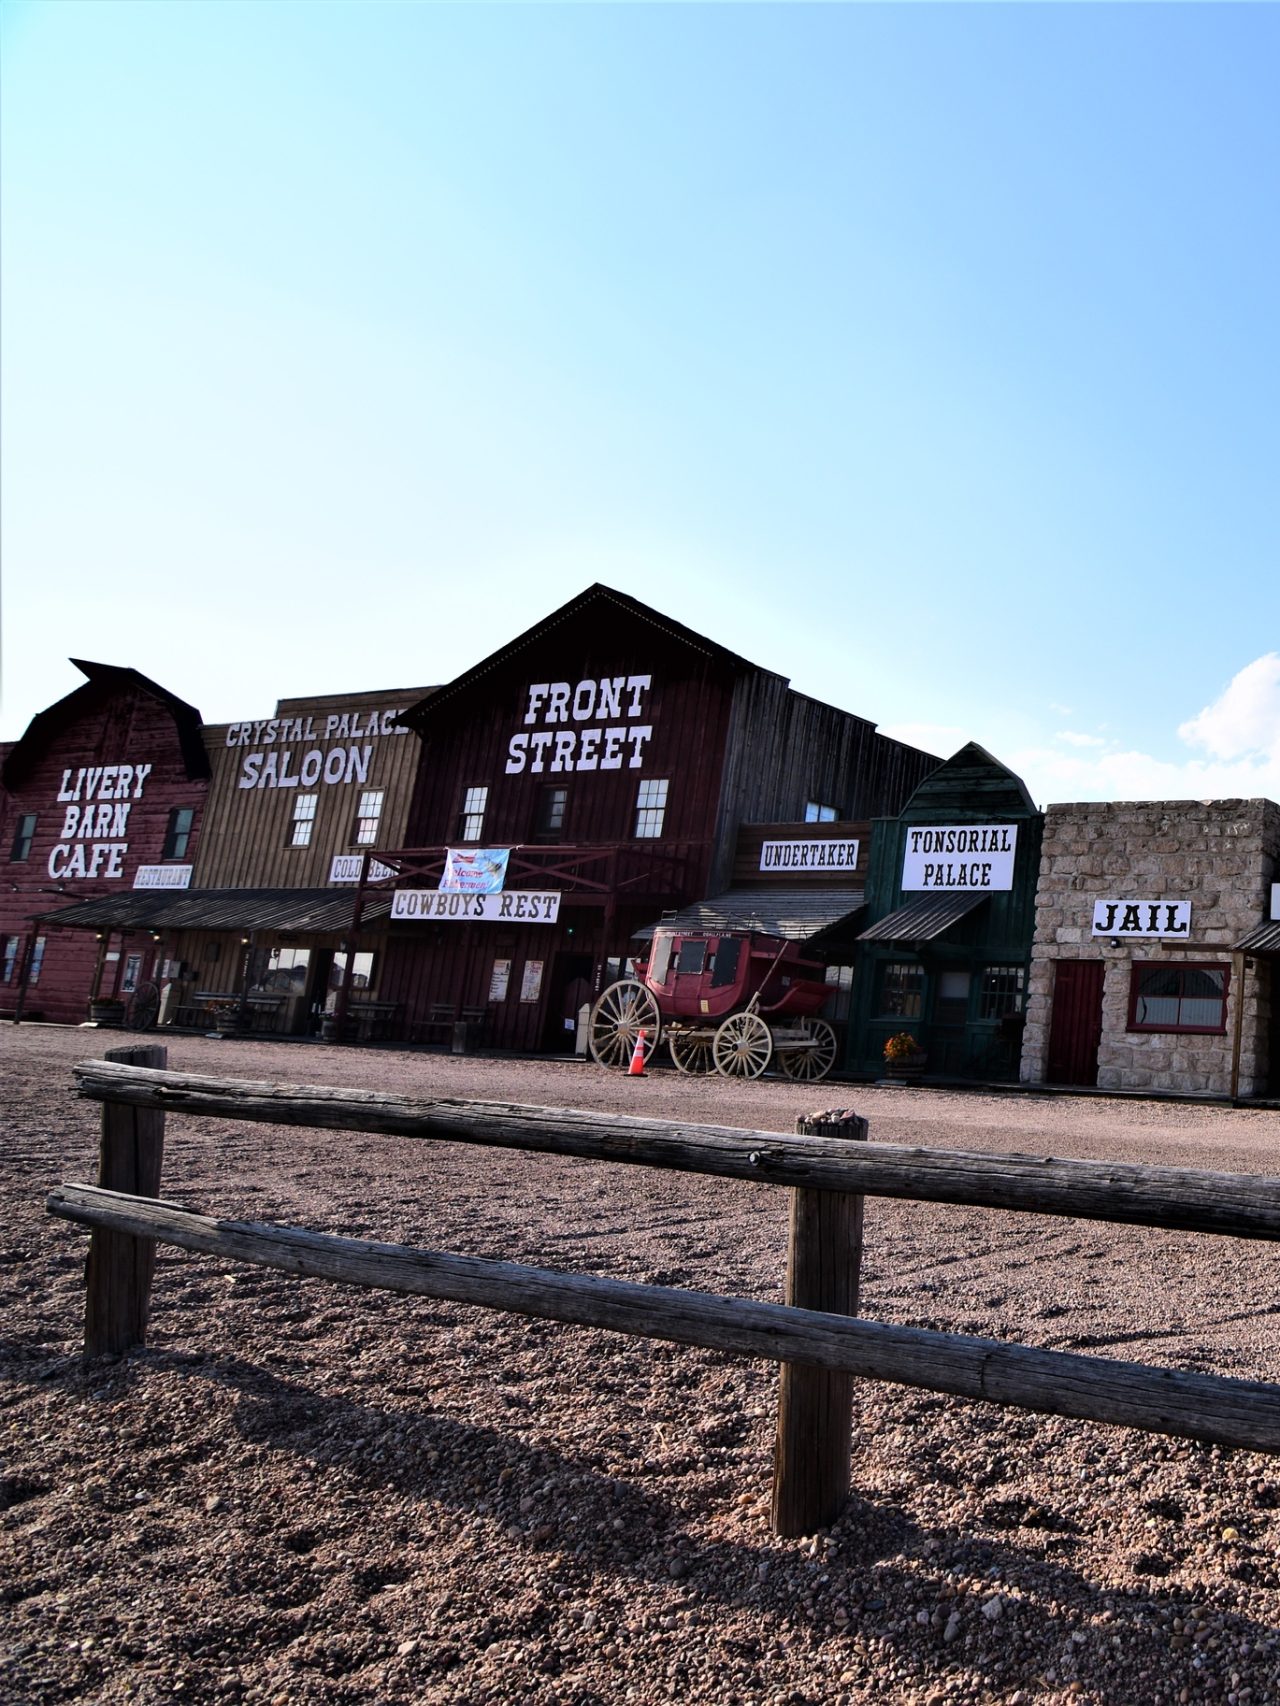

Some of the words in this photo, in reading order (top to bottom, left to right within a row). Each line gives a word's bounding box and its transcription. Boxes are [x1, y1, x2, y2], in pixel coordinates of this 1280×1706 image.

[524, 675, 652, 725] FRONT
[225, 716, 317, 747] CRYSTAL
[505, 725, 653, 774] STREET
[238, 745, 373, 789] SALOON
[56, 764, 152, 802] LIVERY
[60, 803, 131, 839] BARN
[764, 843, 855, 867] UNDERTAKER
[911, 829, 1012, 853] TONSORIAL
[47, 843, 129, 879] CAFE
[334, 859, 363, 878] COLD
[368, 860, 396, 878] BEE
[448, 867, 484, 878] elcome
[922, 862, 992, 887] PALACE
[395, 893, 487, 916] COWBOYS
[499, 894, 558, 918] REST
[1095, 904, 1187, 933] JAIL
